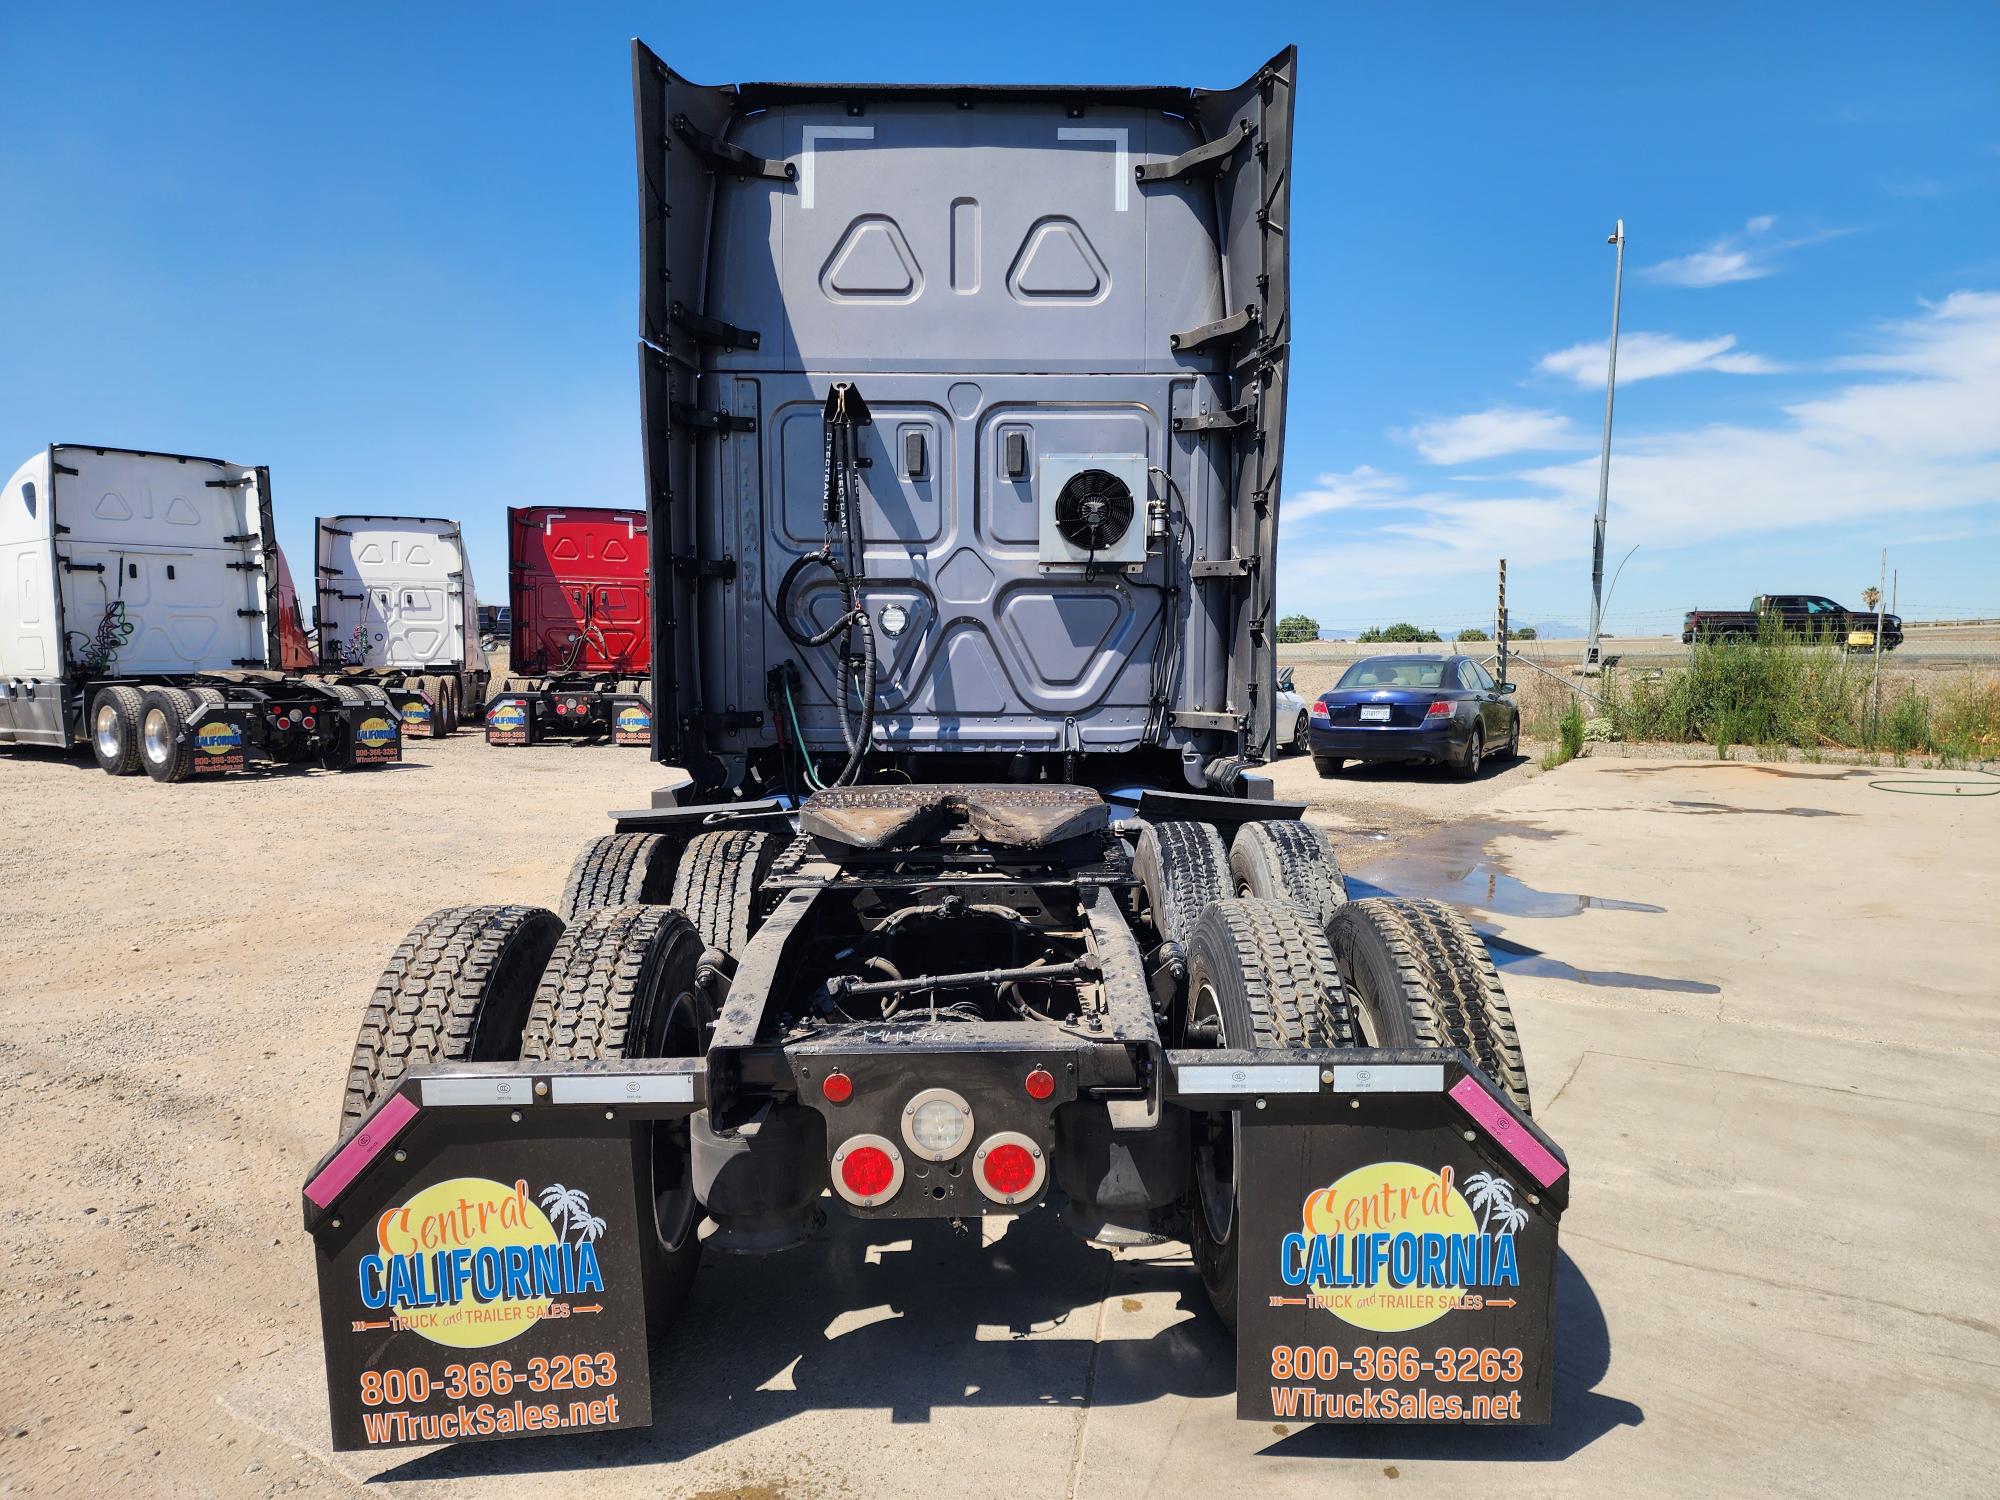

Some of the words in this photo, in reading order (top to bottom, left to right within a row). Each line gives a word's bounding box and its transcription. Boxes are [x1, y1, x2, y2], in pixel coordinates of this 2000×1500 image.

[823, 444, 831, 500] TECTRAN
[838, 473, 847, 528] TECTRAN
[377, 1179, 534, 1259] Central
[1302, 1165, 1455, 1238] Central
[358, 1241, 605, 1310] CALIFORNIA
[1281, 1231, 1520, 1288] CALIFORNIA
[390, 1314, 438, 1332] TRUCK
[443, 1310, 463, 1326] and
[465, 1307, 522, 1324] TRAILER
[526, 1303, 570, 1320] SALES
[1306, 1294, 1352, 1309] TRUCK
[1356, 1292, 1377, 1309] and
[1379, 1294, 1433, 1309] TRAILER
[1438, 1294, 1483, 1310] SALES
[359, 1351, 618, 1406] 800-366-3263
[1270, 1345, 1524, 1383] 800-366-3263
[362, 1394, 620, 1444] WTruckSales.net
[1270, 1387, 1521, 1420] WTruckSales.net
